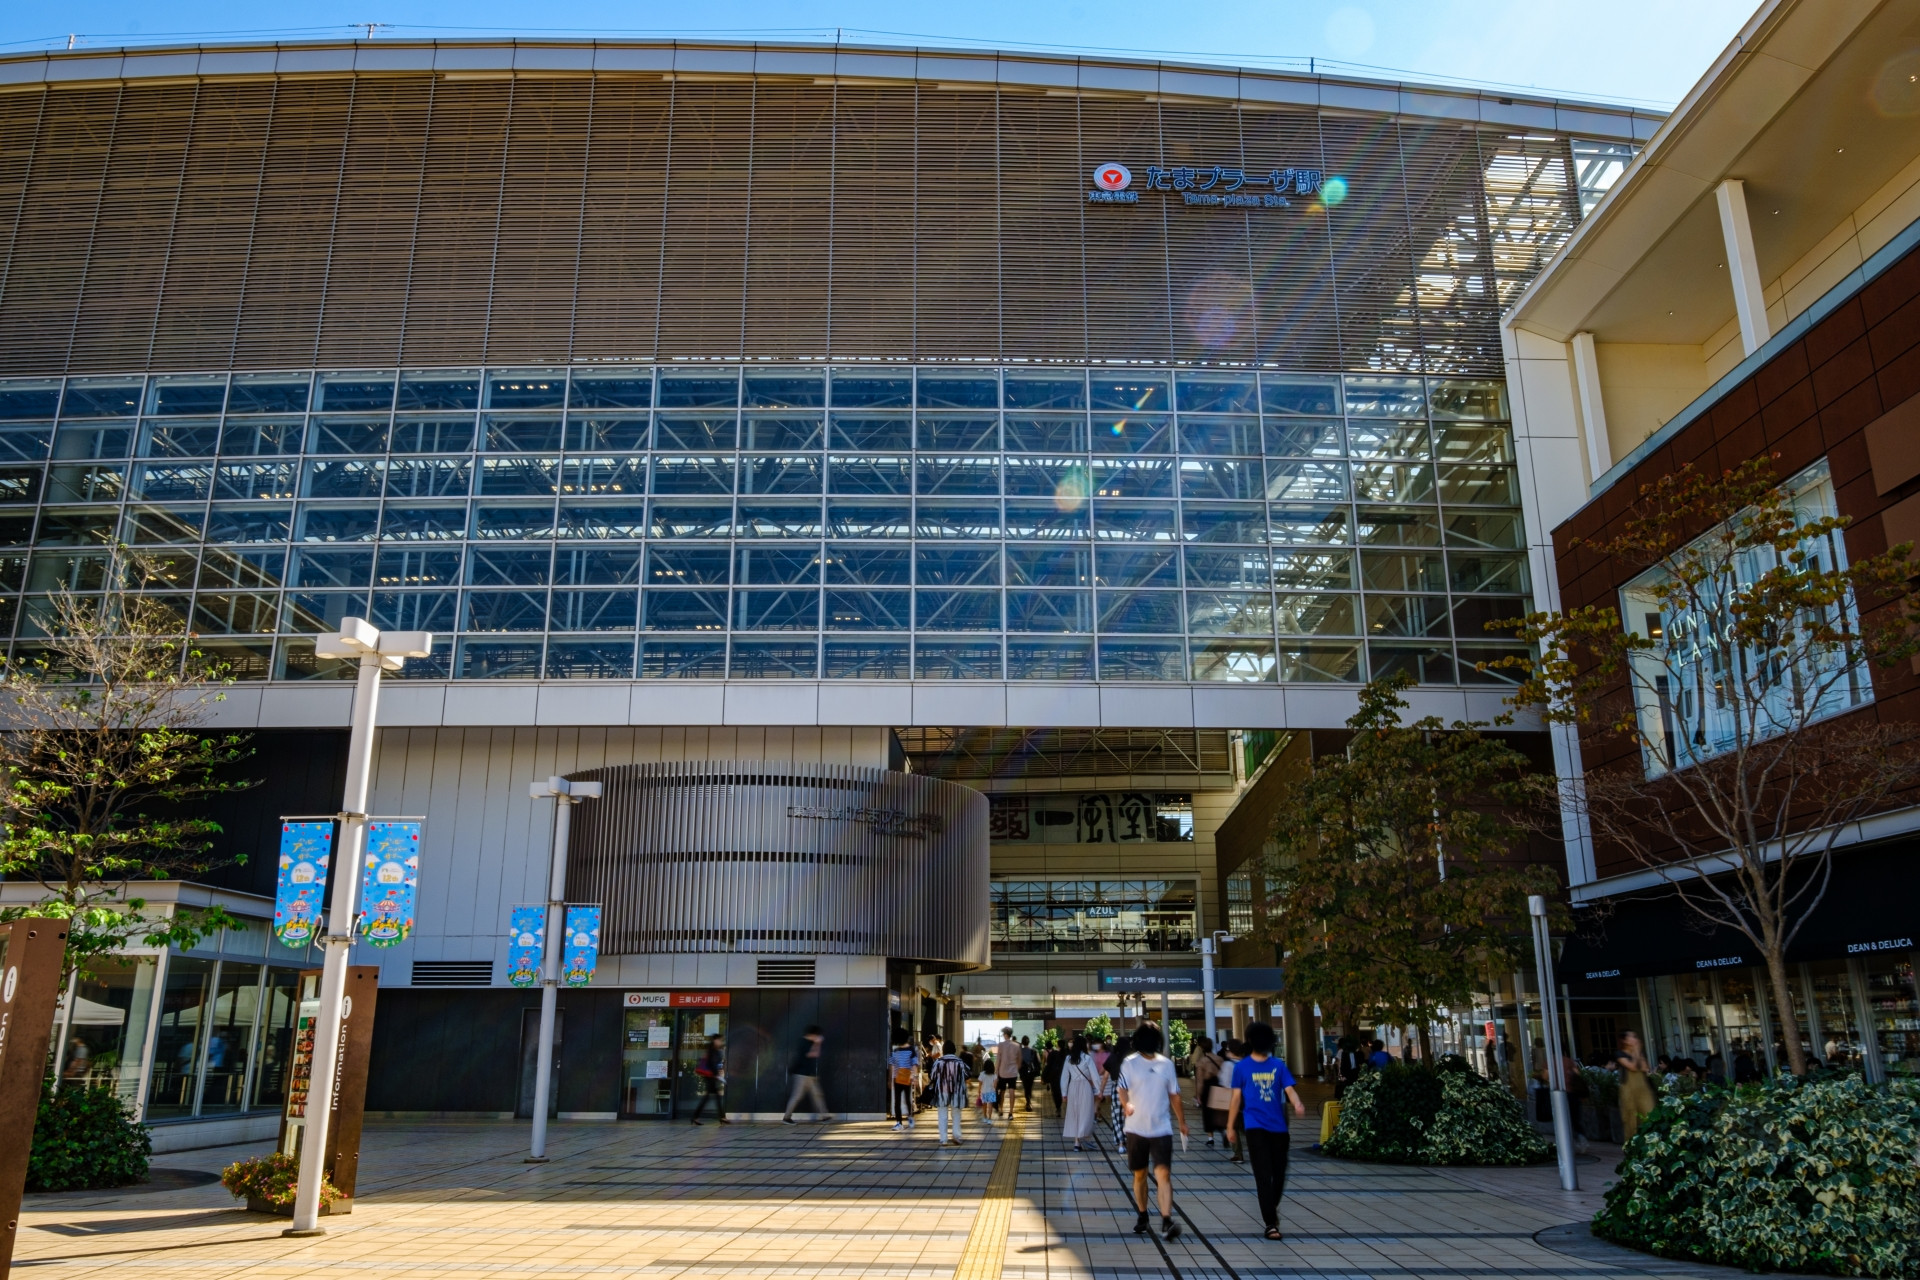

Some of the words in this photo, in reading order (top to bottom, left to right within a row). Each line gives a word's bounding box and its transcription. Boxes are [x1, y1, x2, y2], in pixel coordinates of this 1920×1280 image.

[1146, 165, 1323, 194] たまプラーザ駅
[1034, 793, 1156, 843] 一風堂
[1089, 906, 1115, 915] AZUL
[1847, 942, 1870, 953] DEAN
[1871, 941, 1878, 950] &
[1878, 938, 1913, 949] DELUCA
[1696, 959, 1713, 968] DEAN
[1718, 956, 1743, 966] DELUCA
[642, 995, 666, 1003] MUFG
[678, 995, 720, 1004] 三菱UFJ銀行
[331, 1024, 348, 1110] Information
